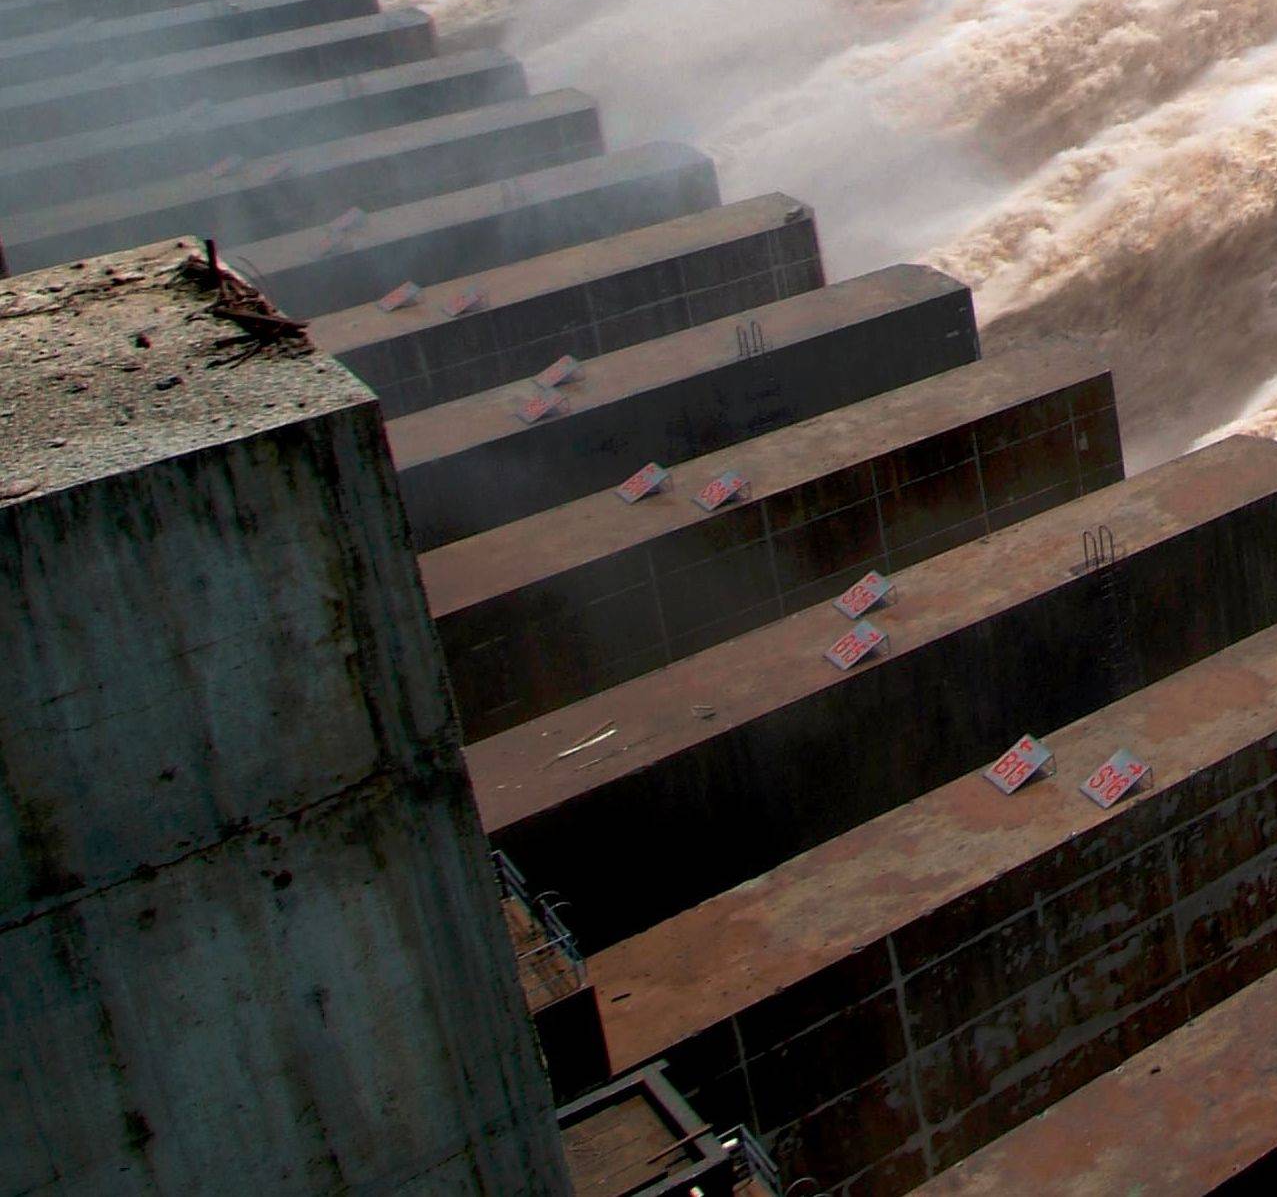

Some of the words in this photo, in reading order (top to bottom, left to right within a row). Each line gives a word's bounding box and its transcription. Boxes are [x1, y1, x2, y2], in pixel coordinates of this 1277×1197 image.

[831, 634, 869, 663] B15
[991, 750, 1033, 787] B15
[1089, 764, 1130, 801] S16
